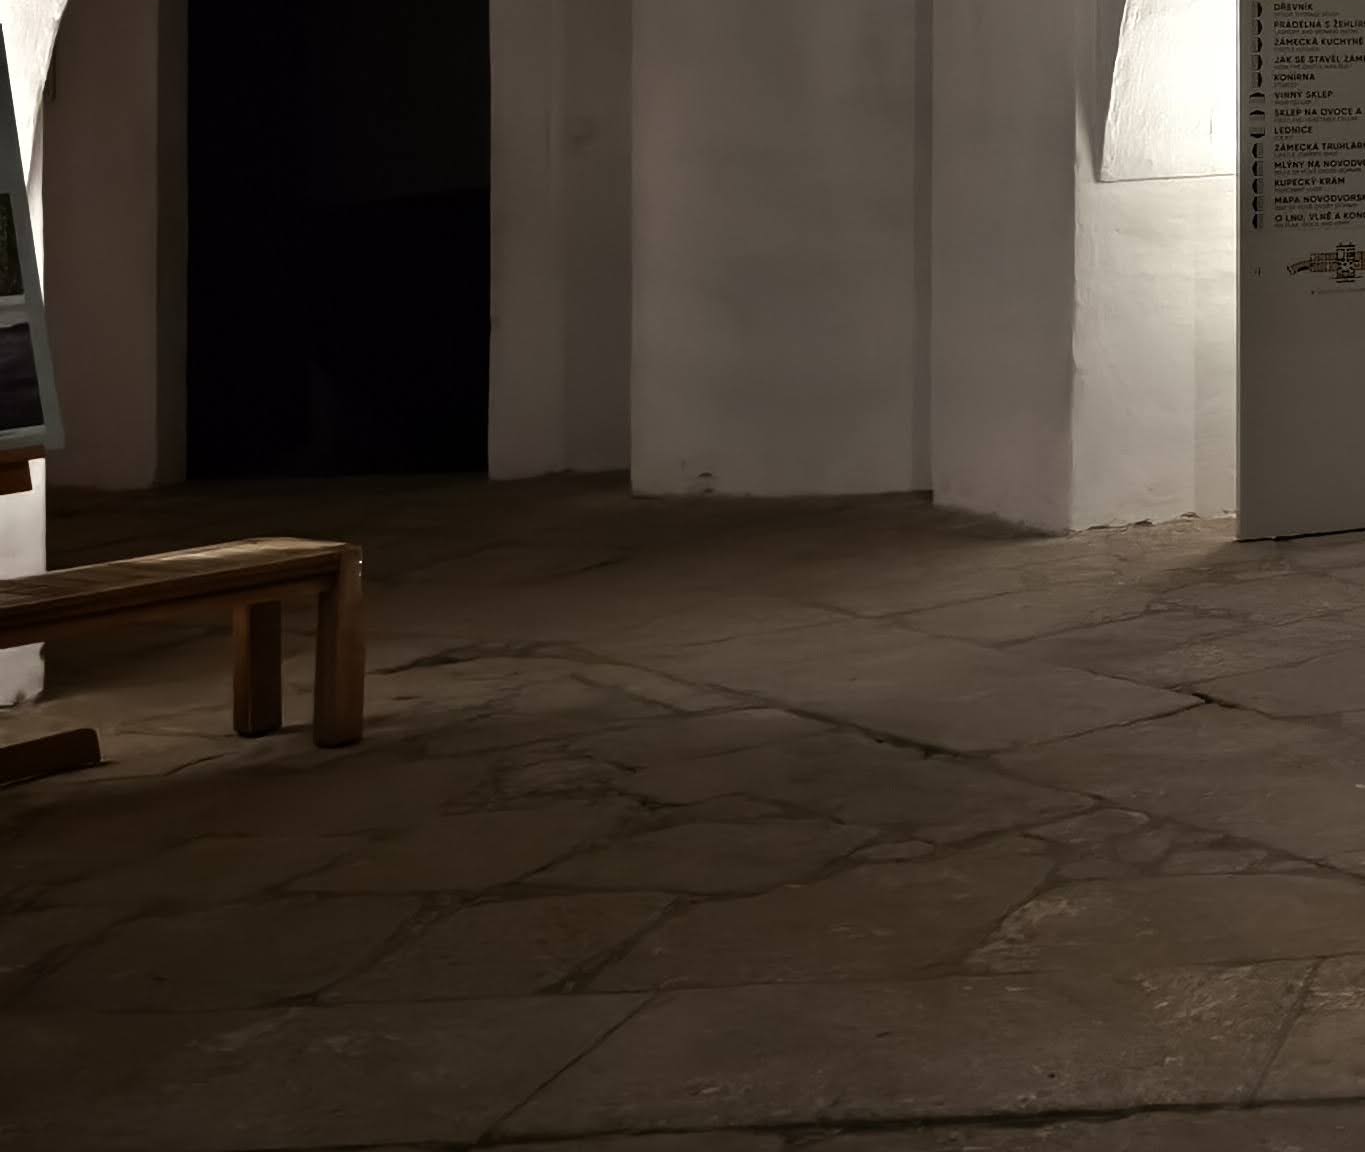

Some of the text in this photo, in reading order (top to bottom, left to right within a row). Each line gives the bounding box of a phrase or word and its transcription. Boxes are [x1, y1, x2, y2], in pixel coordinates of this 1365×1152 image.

[1306, 90, 1333, 98] SKLEP
[1305, 108, 1317, 116] NA
[1321, 107, 1353, 116] OVOCE
[1356, 107, 1362, 115] A
[1274, 126, 1312, 135] LEDNICE
[1308, 160, 1320, 168] NA
[1275, 195, 1300, 204] MAPA
[1275, 214, 1282, 222] O
[1309, 211, 1331, 220] VLNĚ
[1334, 212, 1341, 220] A
